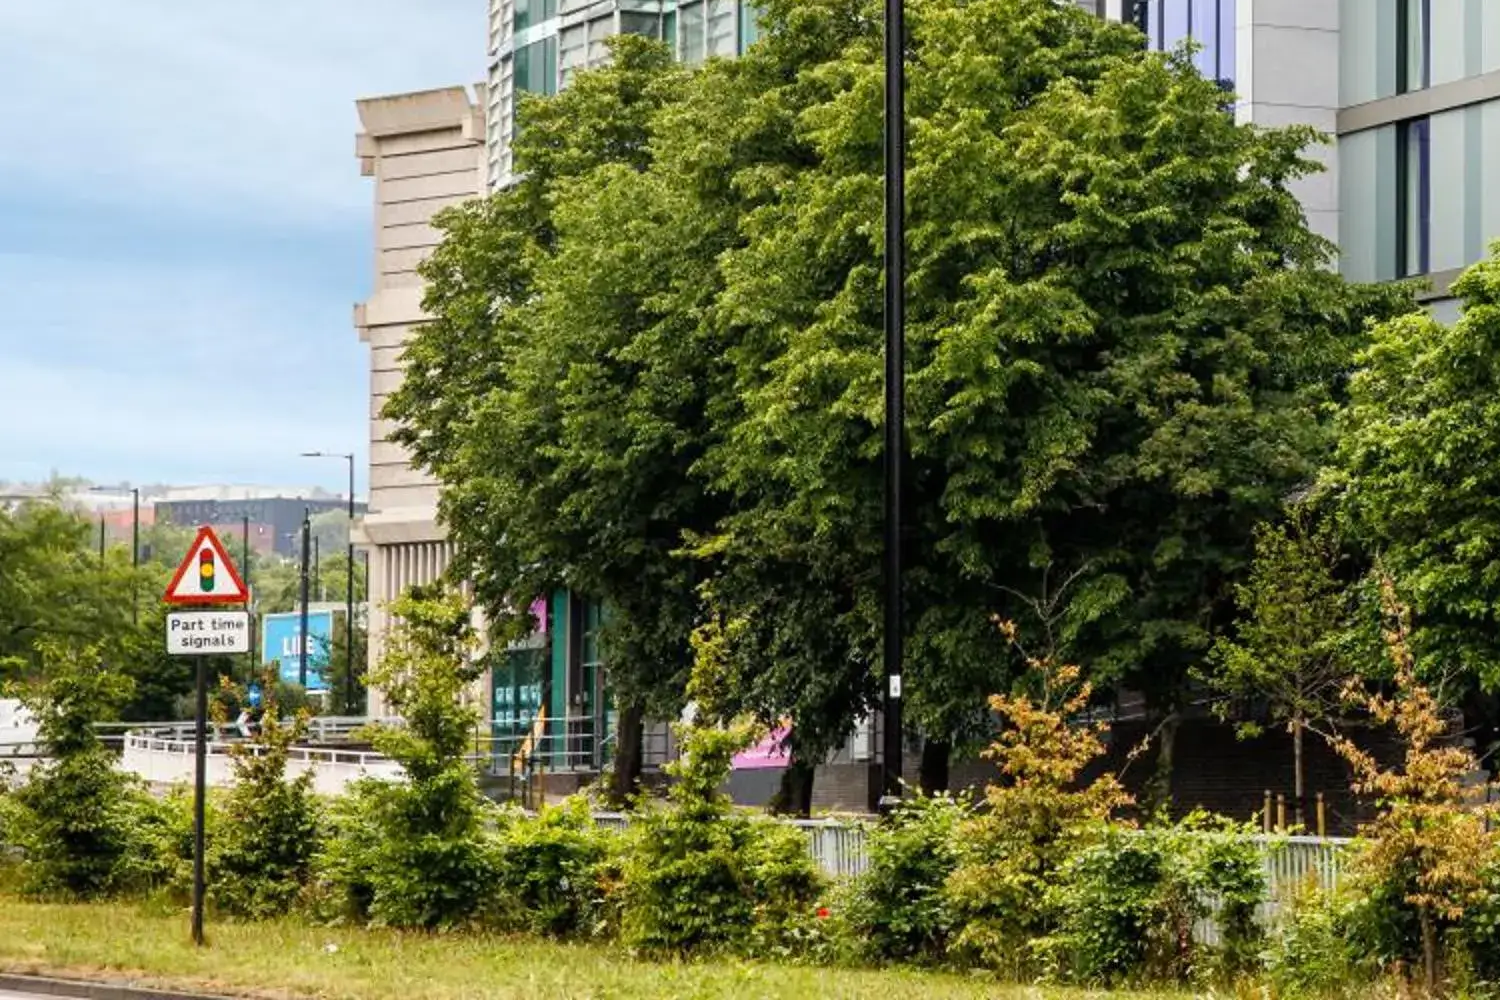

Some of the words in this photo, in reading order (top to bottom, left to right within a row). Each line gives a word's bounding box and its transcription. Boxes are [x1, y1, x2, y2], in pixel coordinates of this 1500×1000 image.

[171, 618, 205, 632] Part
[211, 618, 244, 631] time
[180, 634, 235, 649] signals
